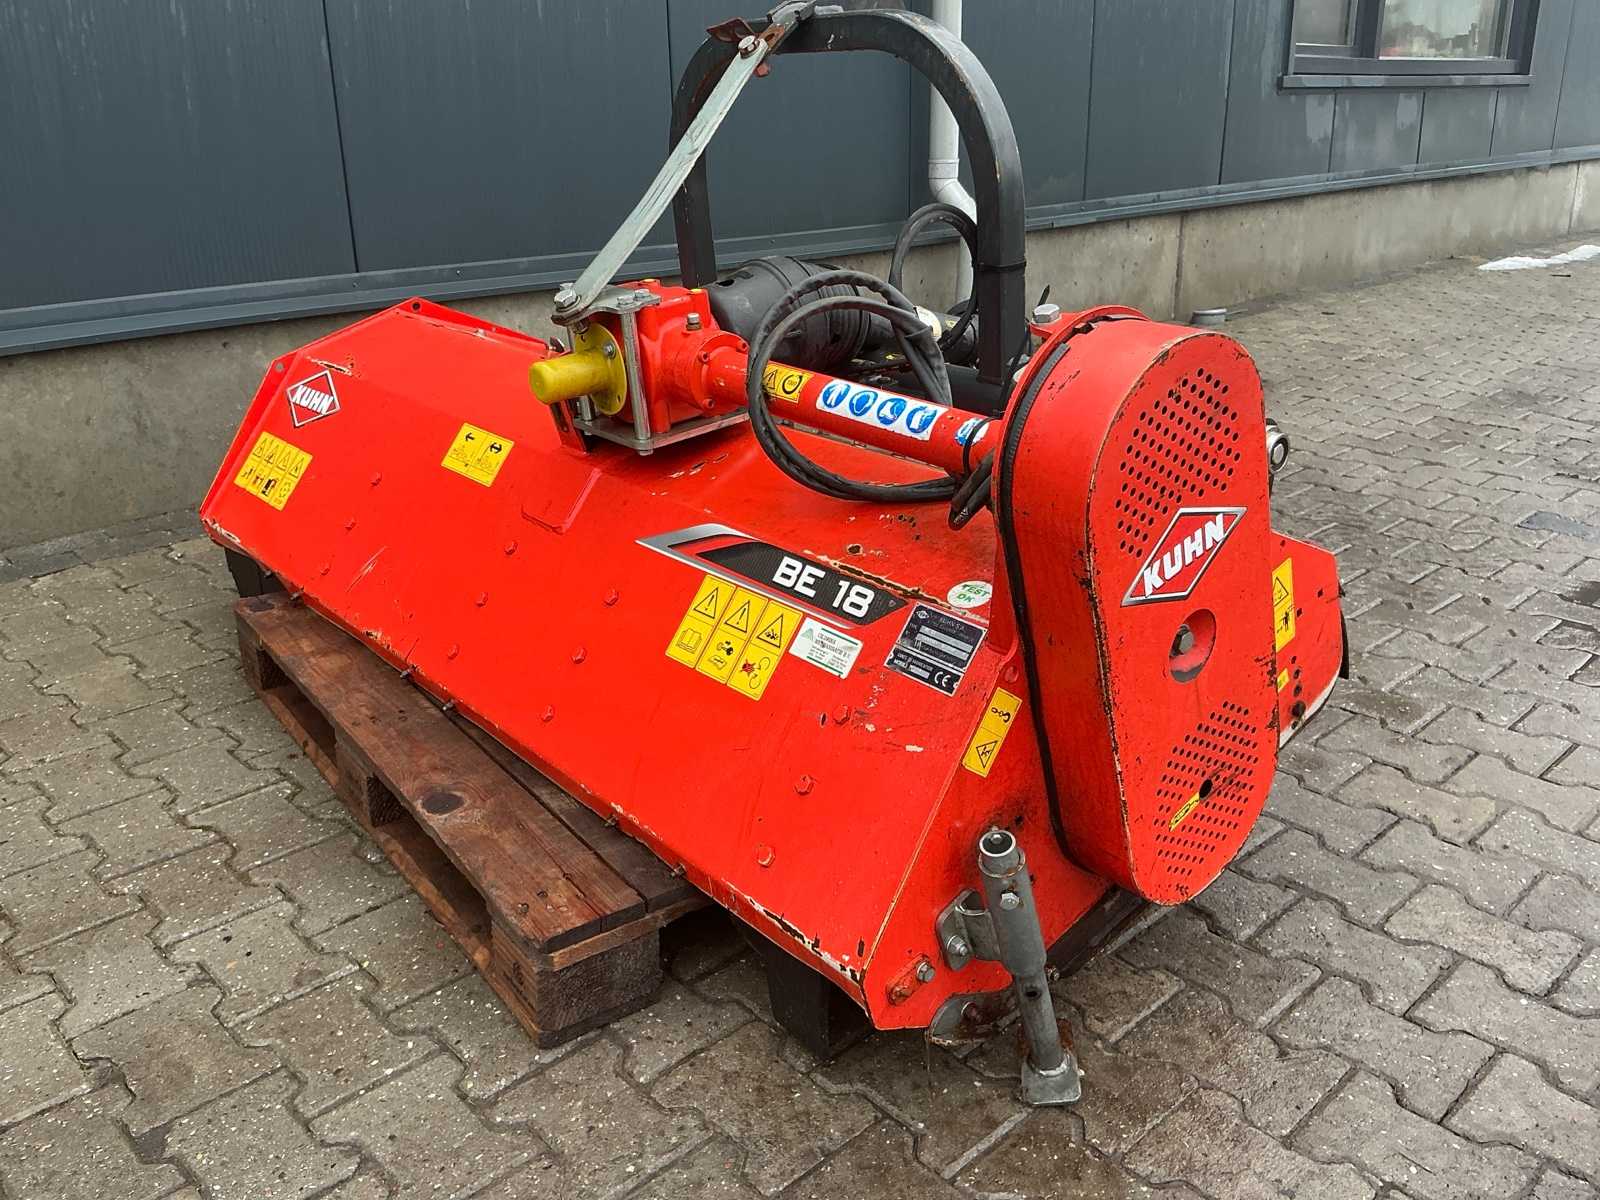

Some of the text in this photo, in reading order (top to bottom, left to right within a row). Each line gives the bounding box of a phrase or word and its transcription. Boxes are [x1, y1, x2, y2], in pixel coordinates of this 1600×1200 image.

[291, 384, 334, 415] KUHN
[1143, 513, 1225, 598] KUHN
[772, 556, 875, 618] BE 18
[956, 593, 975, 602] OK
[962, 584, 991, 597] TEST
